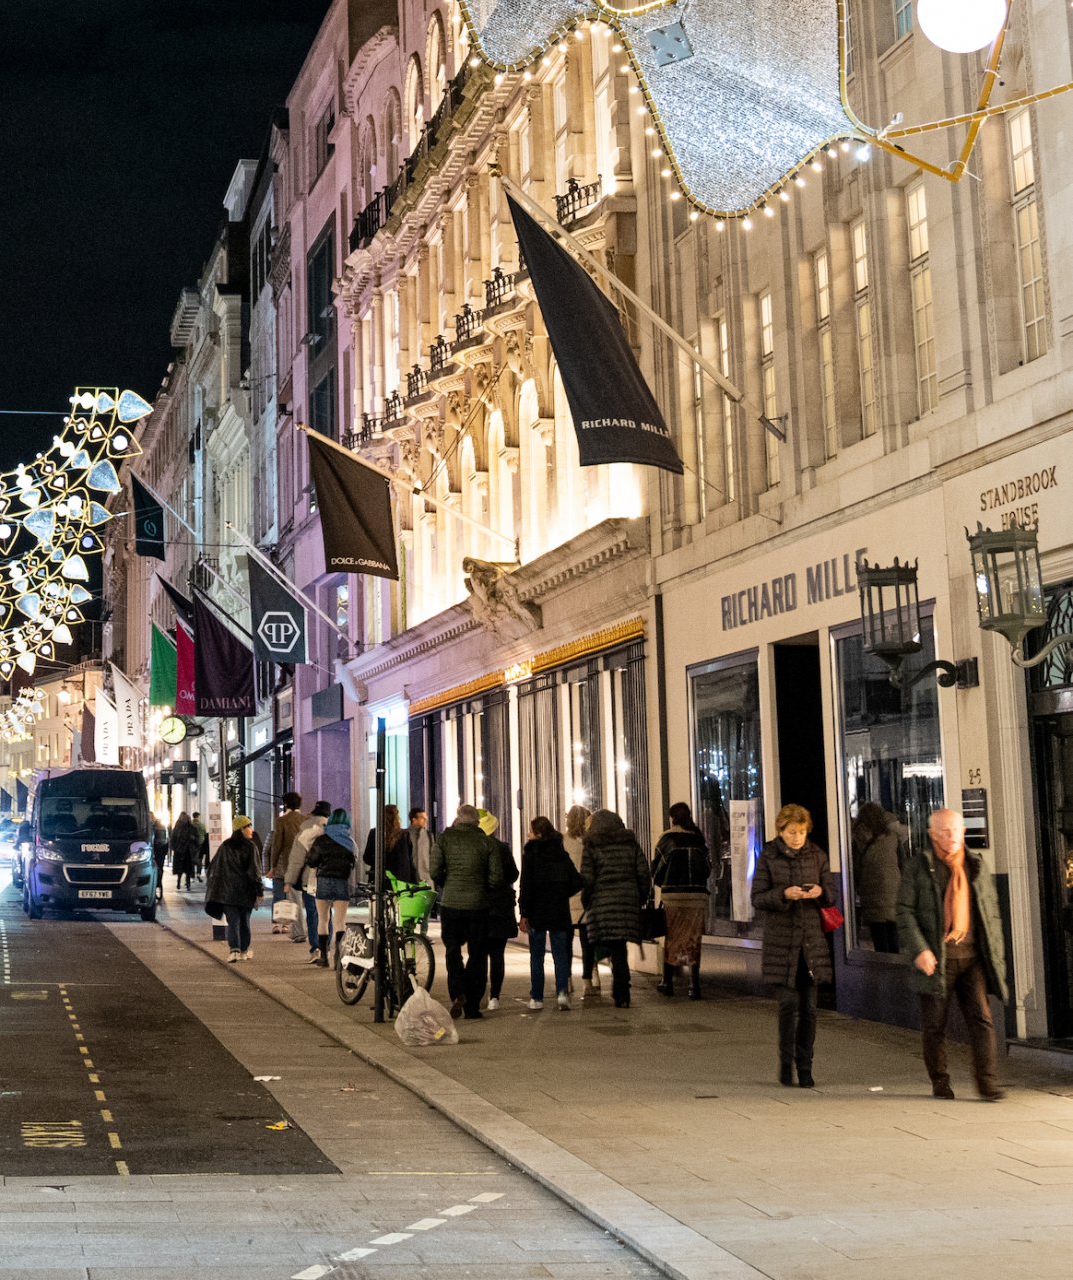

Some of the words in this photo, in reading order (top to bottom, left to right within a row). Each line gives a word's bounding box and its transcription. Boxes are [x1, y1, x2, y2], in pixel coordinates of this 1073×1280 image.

[581, 418, 636, 430] RICHARD
[980, 465, 1058, 512] STANDBROOK
[721, 572, 797, 631] RICHARD
[200, 695, 252, 710] DAMIANI
